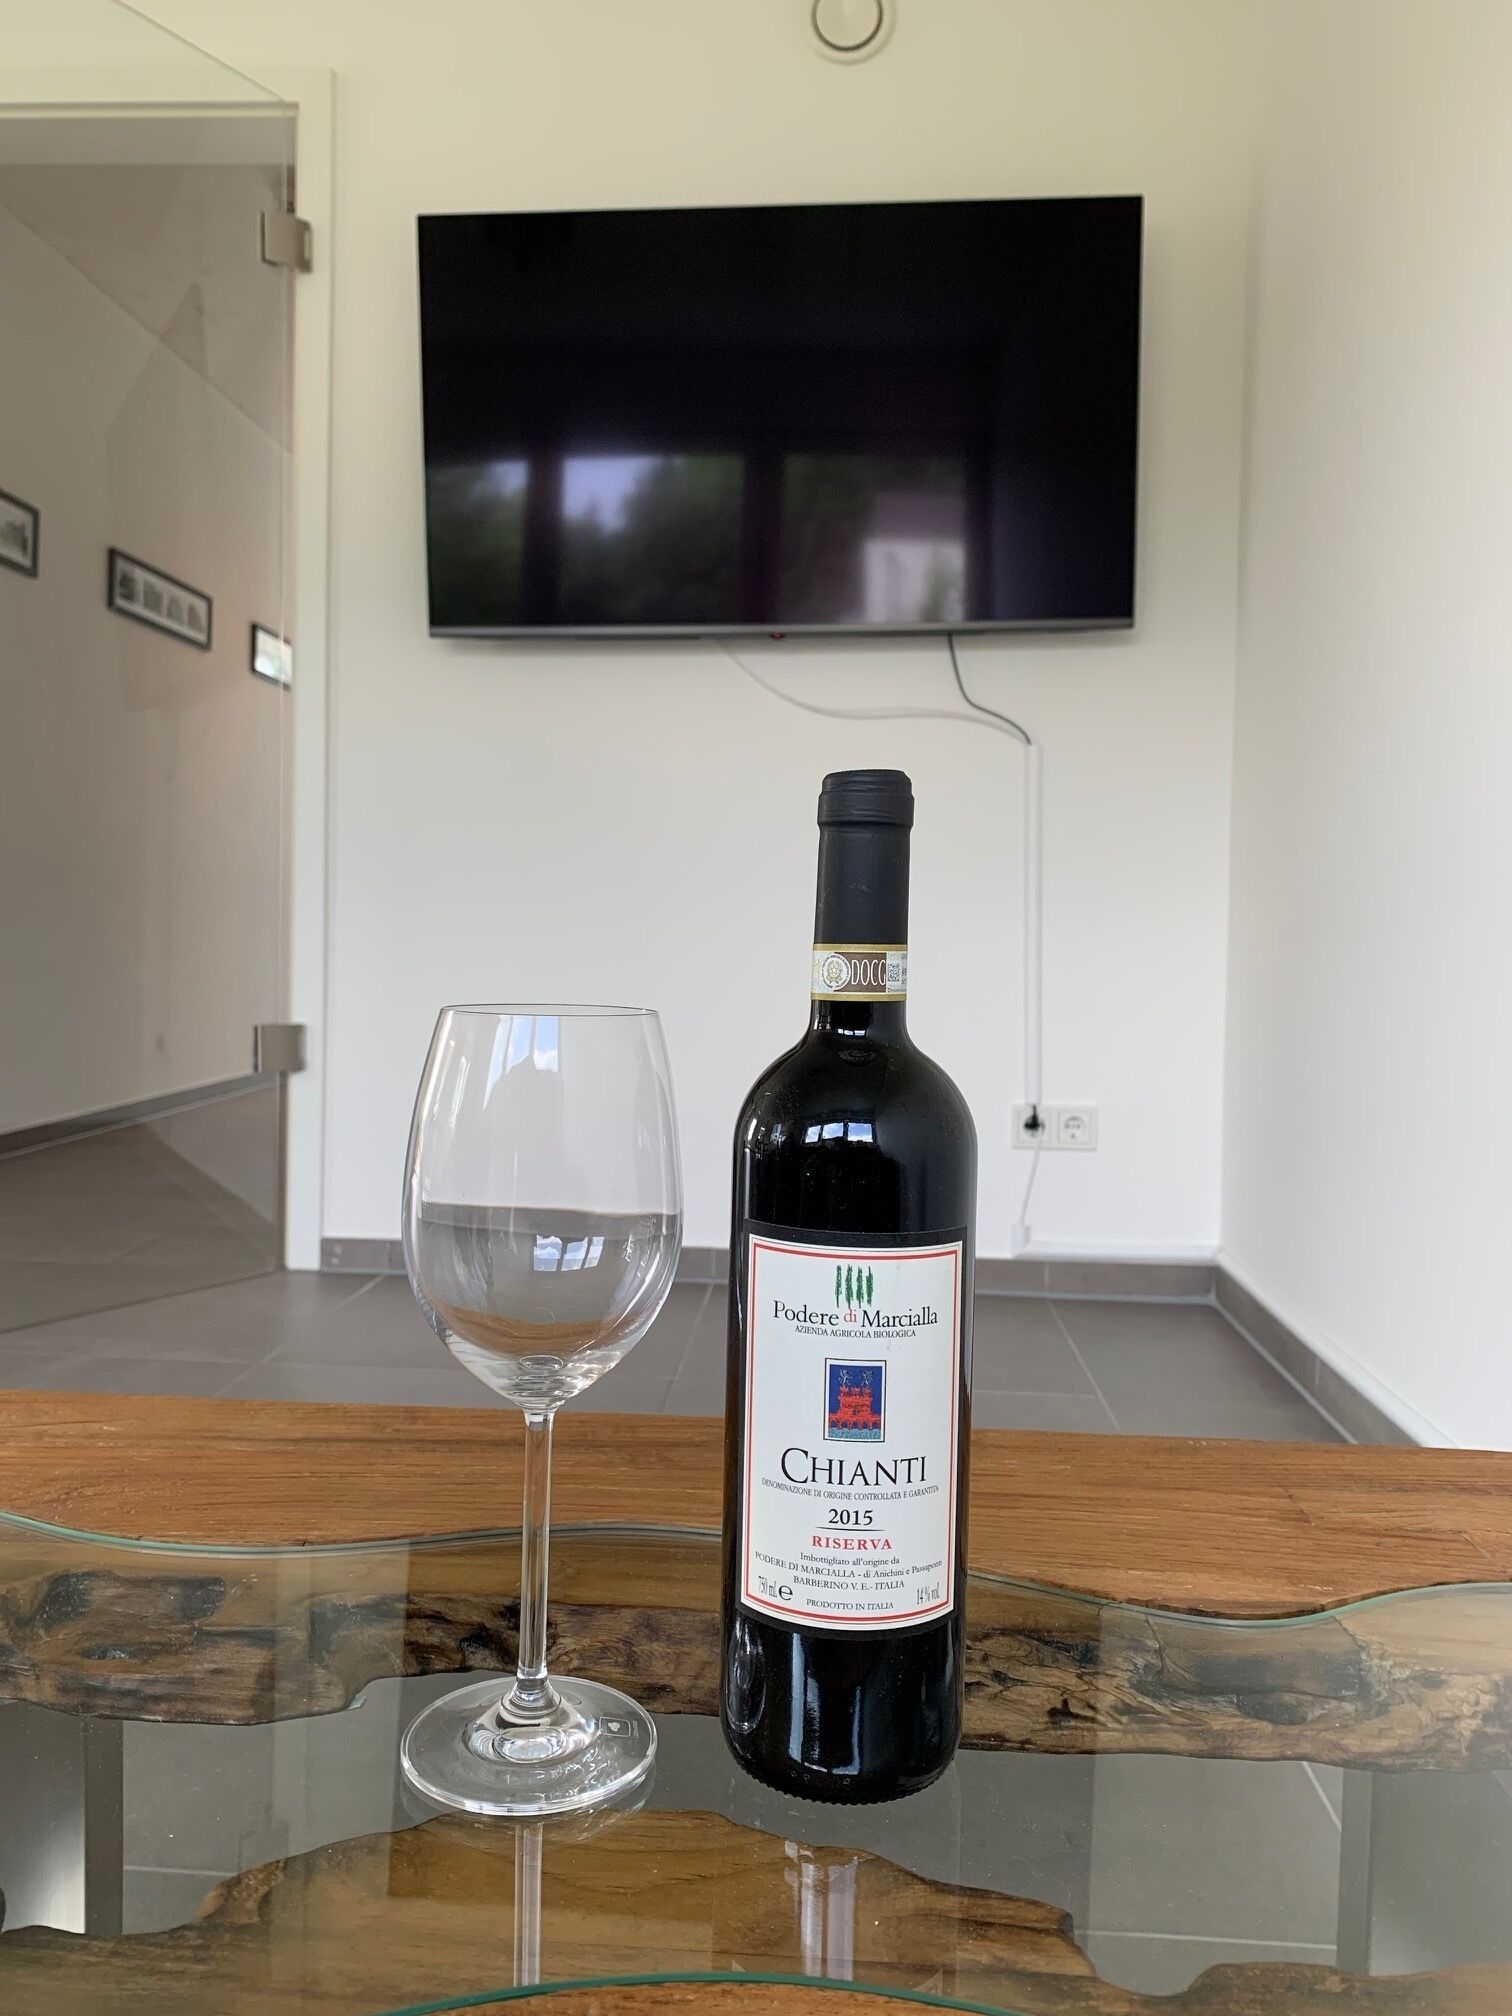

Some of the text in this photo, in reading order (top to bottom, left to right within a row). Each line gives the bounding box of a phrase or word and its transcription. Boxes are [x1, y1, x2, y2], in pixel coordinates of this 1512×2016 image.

[851, 959, 886, 986] DOCG
[773, 1300, 938, 1328] Podere di Marcialla
[795, 1325, 916, 1339] AZIENDA AGRICOLA BIOLOGICA
[781, 1447, 926, 1486] CHIANTI
[761, 1477, 939, 1501] DENOMINAZIONE DI ORIGINE CONTROLLATA E GARANTITA
[828, 1508, 874, 1526] 2015
[812, 1535, 893, 1551] RISERVA
[755, 1550, 787, 1569] PODERE
[788, 1561, 799, 1571] DI
[800, 1564, 855, 1578] MARCIALLA
[863, 1569, 871, 1578] di
[873, 1568, 905, 1579] Anichini
[800, 1552, 900, 1568] Imbottigliato all'origine da
[793, 1575, 849, 1591] BARBERINO
[875, 1580, 905, 1590] ITALIA
[806, 1598, 894, 1611] PRODOTTO IN ITALIA
